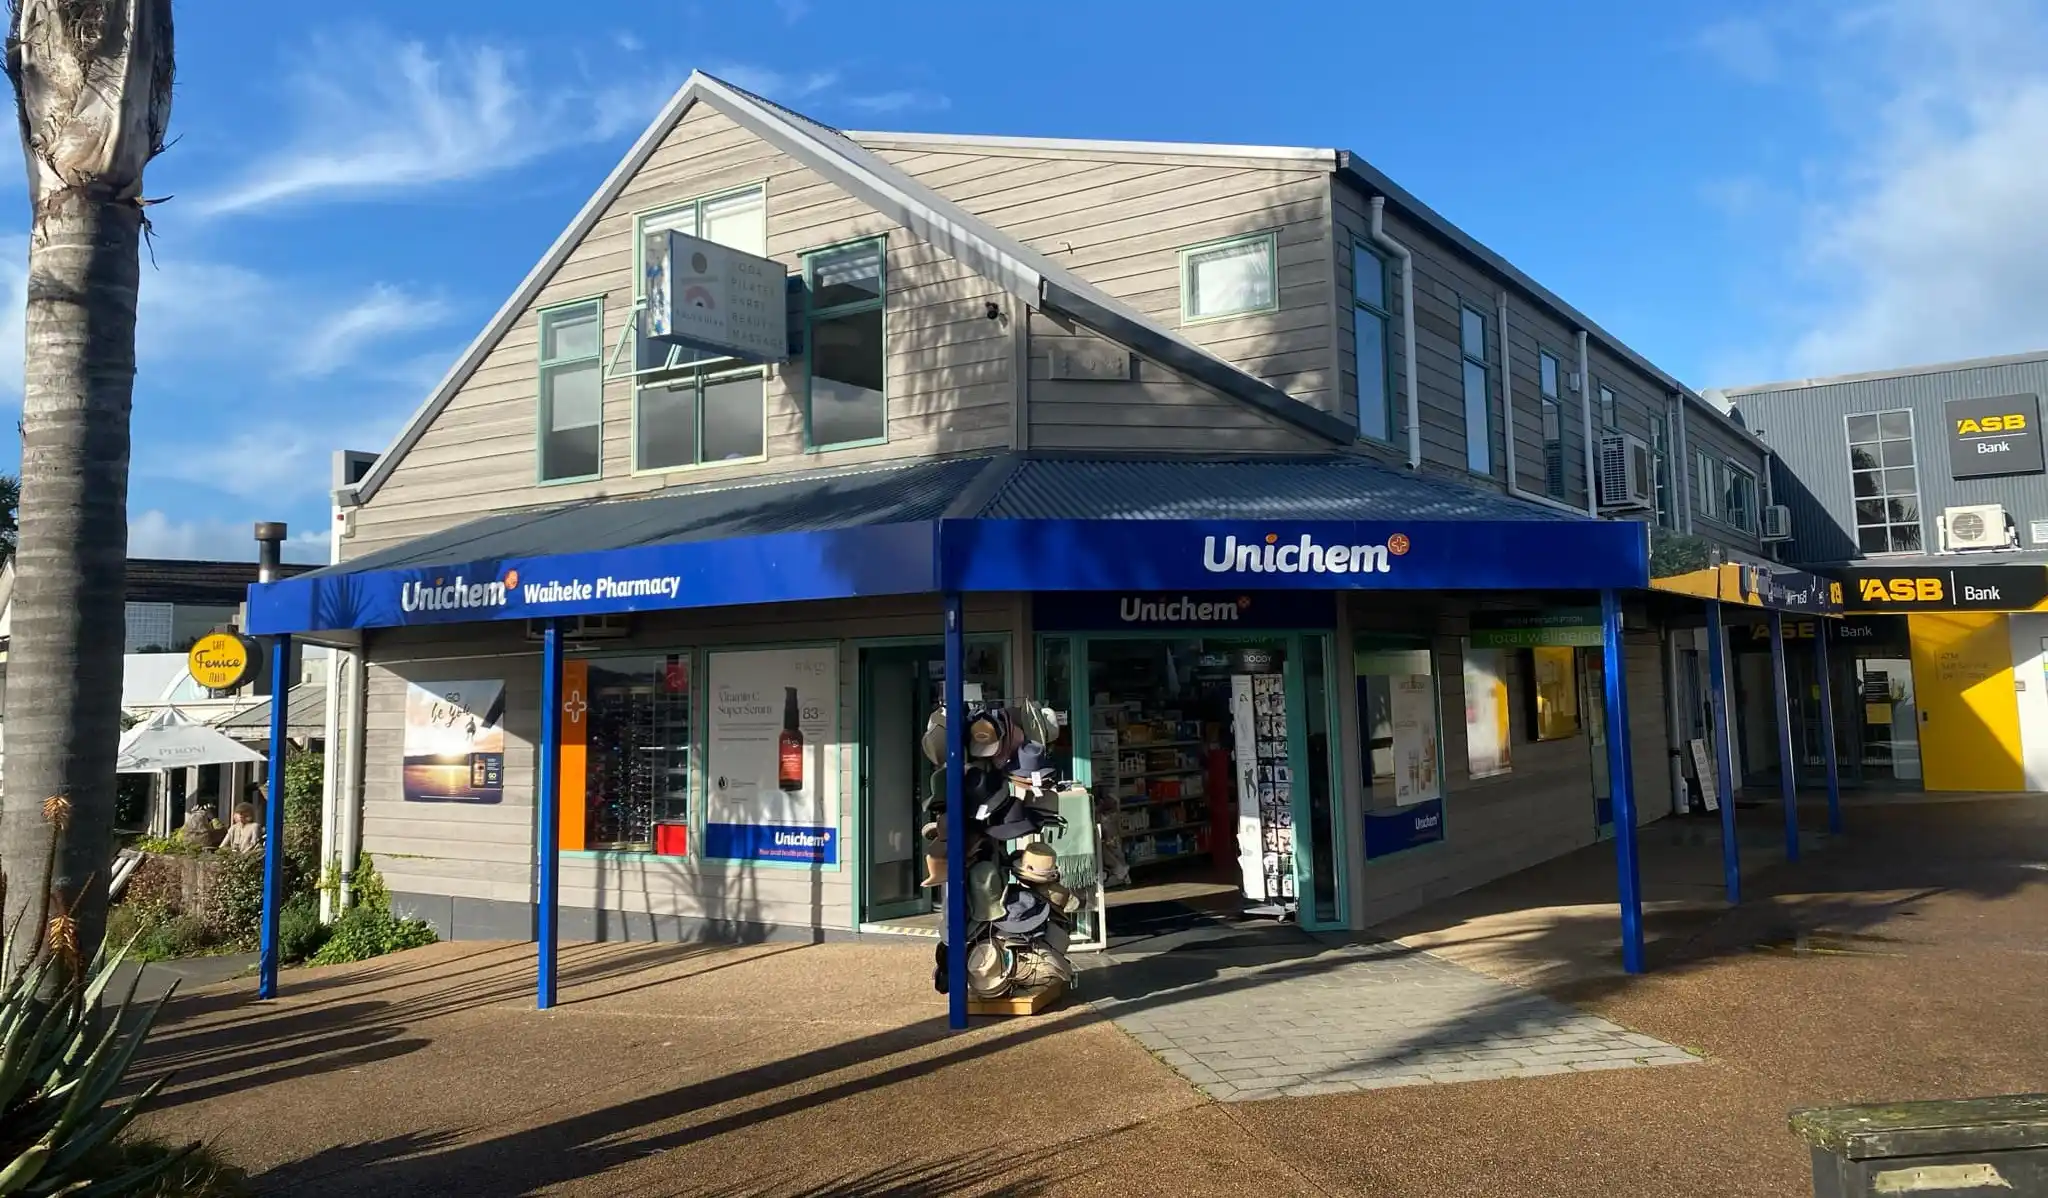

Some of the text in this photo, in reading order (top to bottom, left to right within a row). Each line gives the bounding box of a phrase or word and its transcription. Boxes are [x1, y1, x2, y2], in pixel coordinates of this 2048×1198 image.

[1956, 414, 2026, 435] ASB
[1977, 441, 2010, 454] Bank
[1203, 534, 1391, 574] Unichem
[401, 575, 680, 612] Unichem Waiheke Pharmacy
[1859, 578, 1944, 602] ASB
[1964, 586, 2001, 601] Bank
[1120, 596, 1239, 622] Unichem
[1489, 630, 1601, 645] total wellbeing
[1840, 625, 1874, 638] Bank
[194, 649, 242, 670] Fenice
[431, 701, 472, 728] be you
[158, 744, 206, 756] PERONI
[775, 831, 825, 847] Unichem
